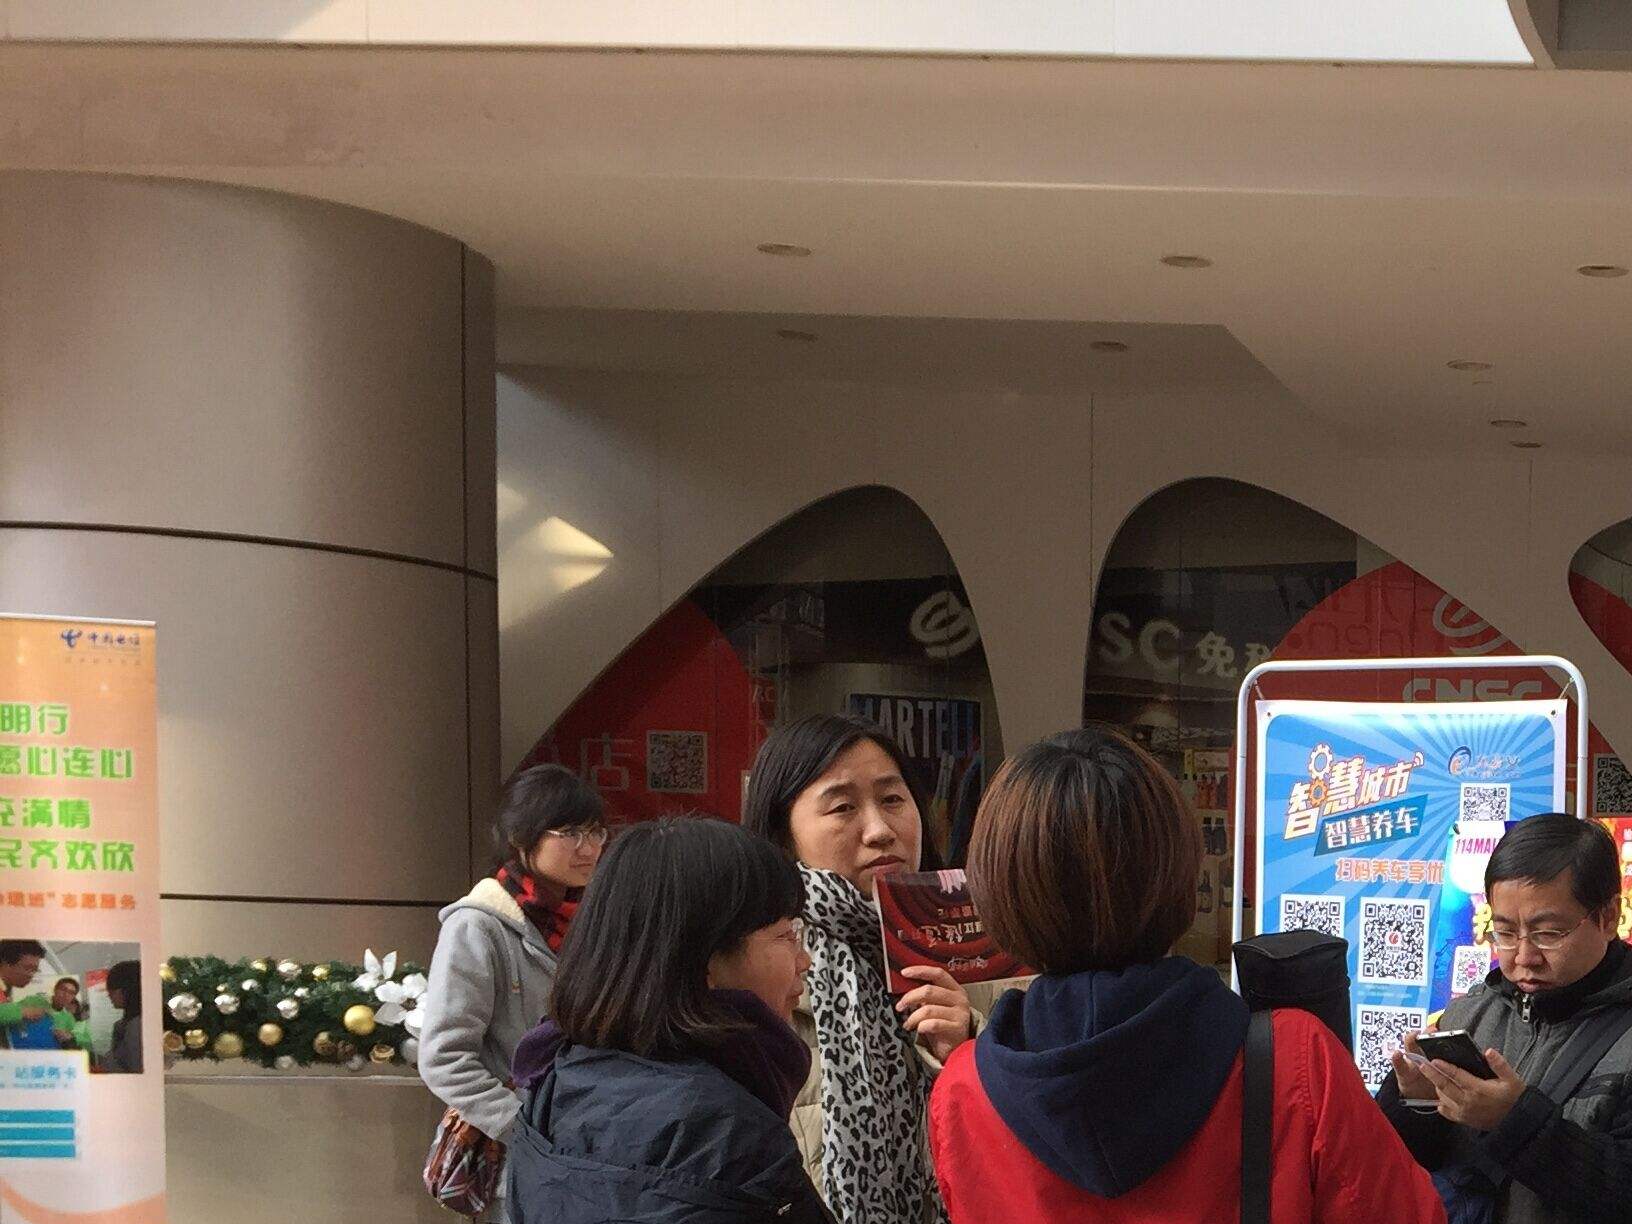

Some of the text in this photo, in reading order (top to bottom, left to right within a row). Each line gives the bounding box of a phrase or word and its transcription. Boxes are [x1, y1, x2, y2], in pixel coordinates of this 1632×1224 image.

[1284, 756, 1413, 840] 智慧城市
[1324, 806, 1421, 849] 智慧养车
